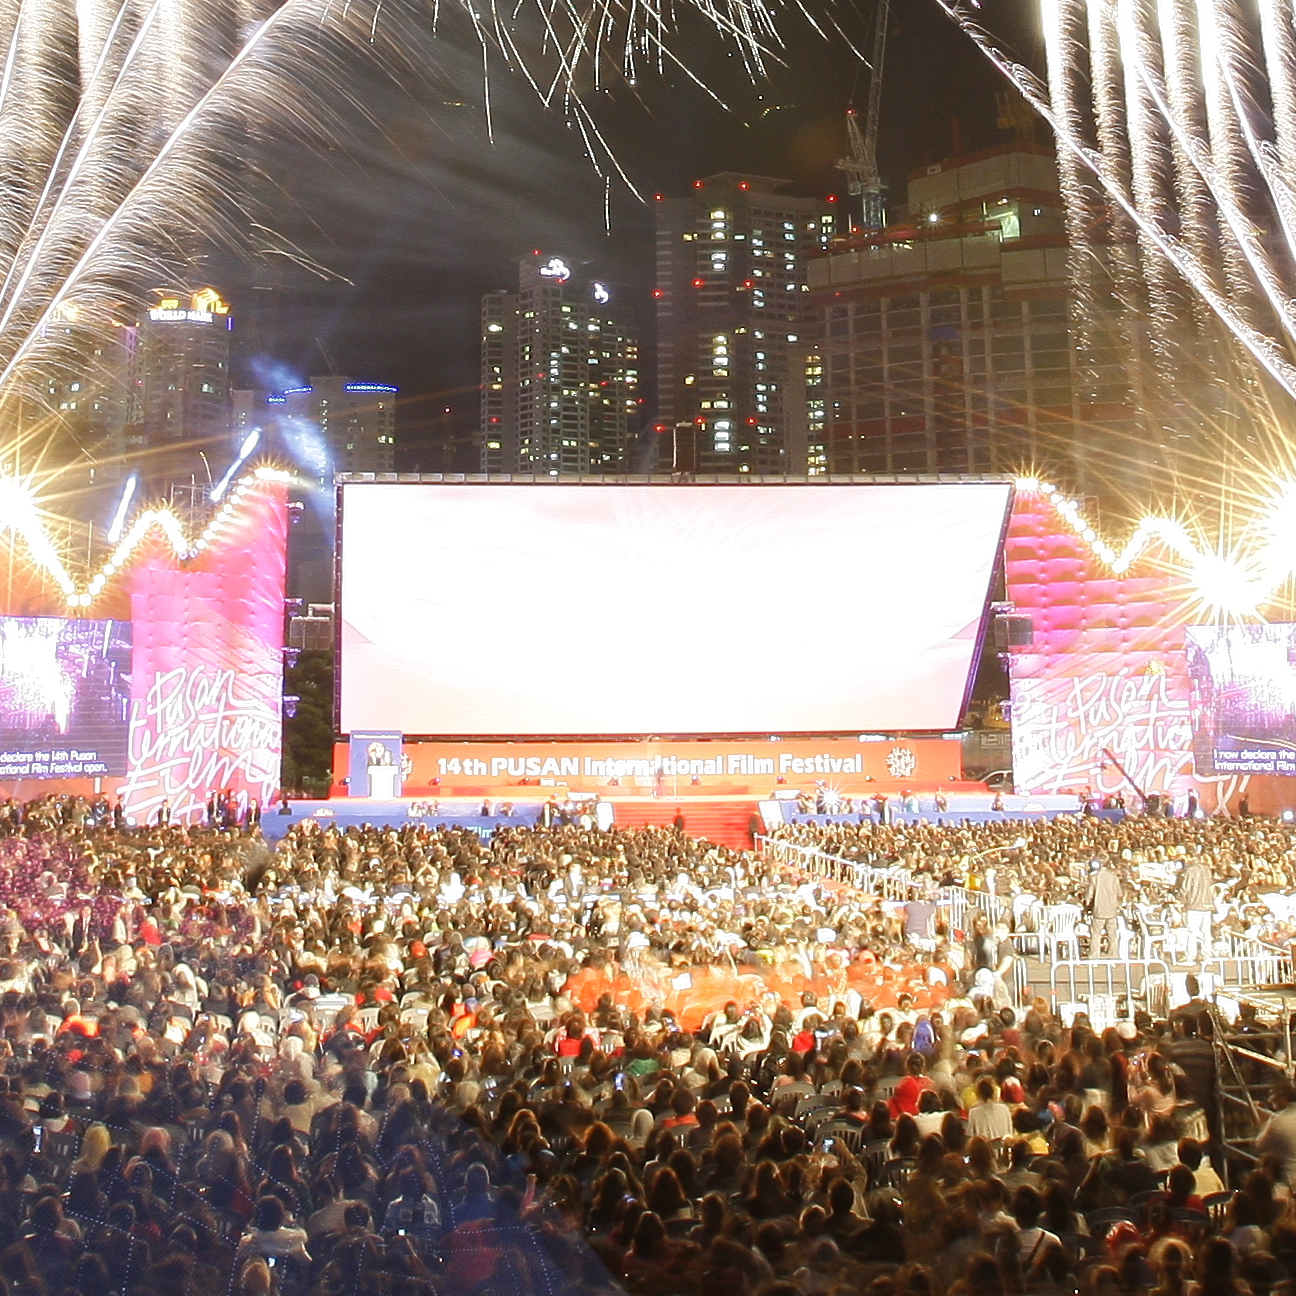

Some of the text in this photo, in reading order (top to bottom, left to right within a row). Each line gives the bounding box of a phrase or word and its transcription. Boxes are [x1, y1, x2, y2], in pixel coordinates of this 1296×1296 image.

[438, 757, 487, 776] 14th
[491, 757, 578, 777] PUSAN
[727, 754, 775, 775] Film
[779, 753, 863, 774] Festival
